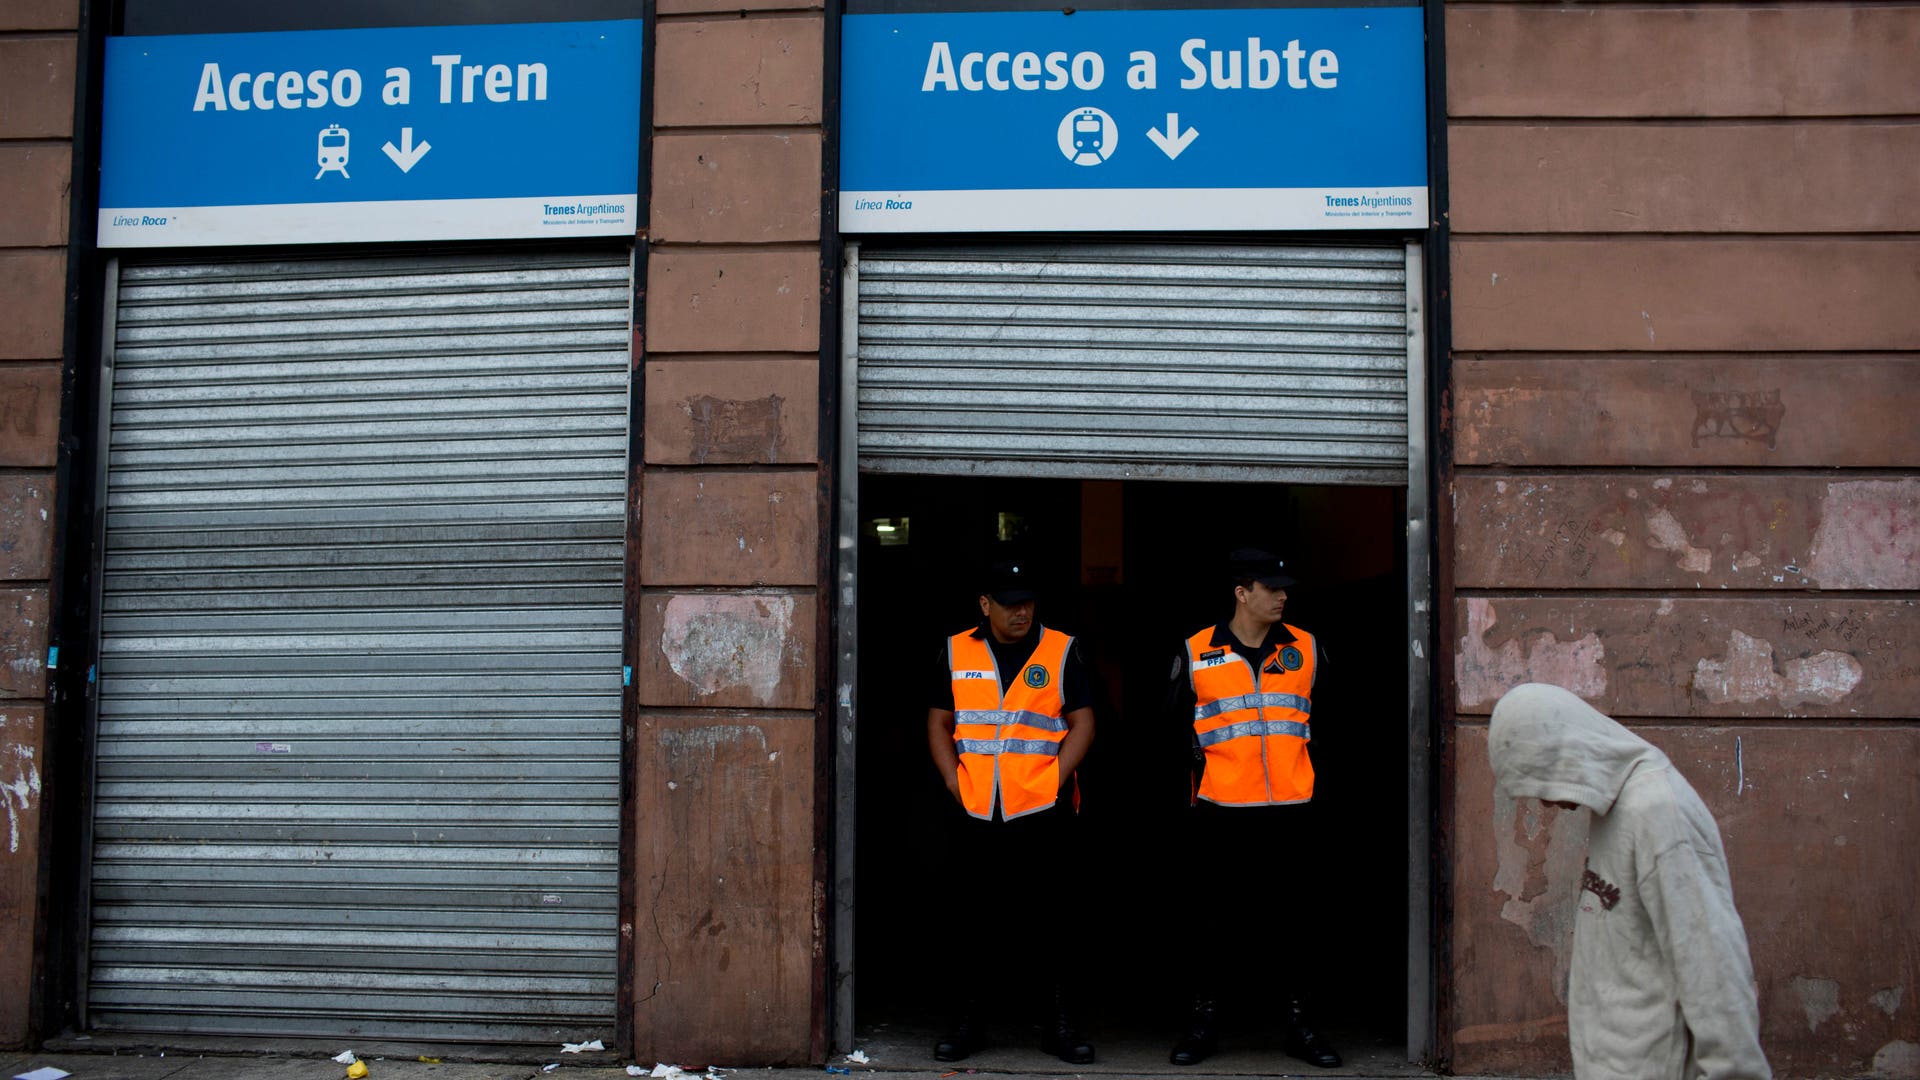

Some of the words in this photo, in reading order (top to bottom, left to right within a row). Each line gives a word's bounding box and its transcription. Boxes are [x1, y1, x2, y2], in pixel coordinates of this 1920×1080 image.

[921, 41, 1105, 92] Acceso
[1126, 50, 1157, 90] a
[1180, 36, 1339, 90] Subte
[193, 62, 362, 112] Acceso
[382, 67, 411, 106] a
[431, 54, 548, 103] Tren
[856, 198, 883, 210] Línea
[885, 199, 913, 210] Roca
[1325, 195, 1359, 207] Trenes
[1360, 195, 1412, 209] Argentinos
[543, 204, 576, 216] Trenes
[576, 203, 625, 216] Argentinos
[141, 215, 168, 226] Roca
[1207, 657, 1226, 667] PFA
[965, 671, 983, 679] PFA
